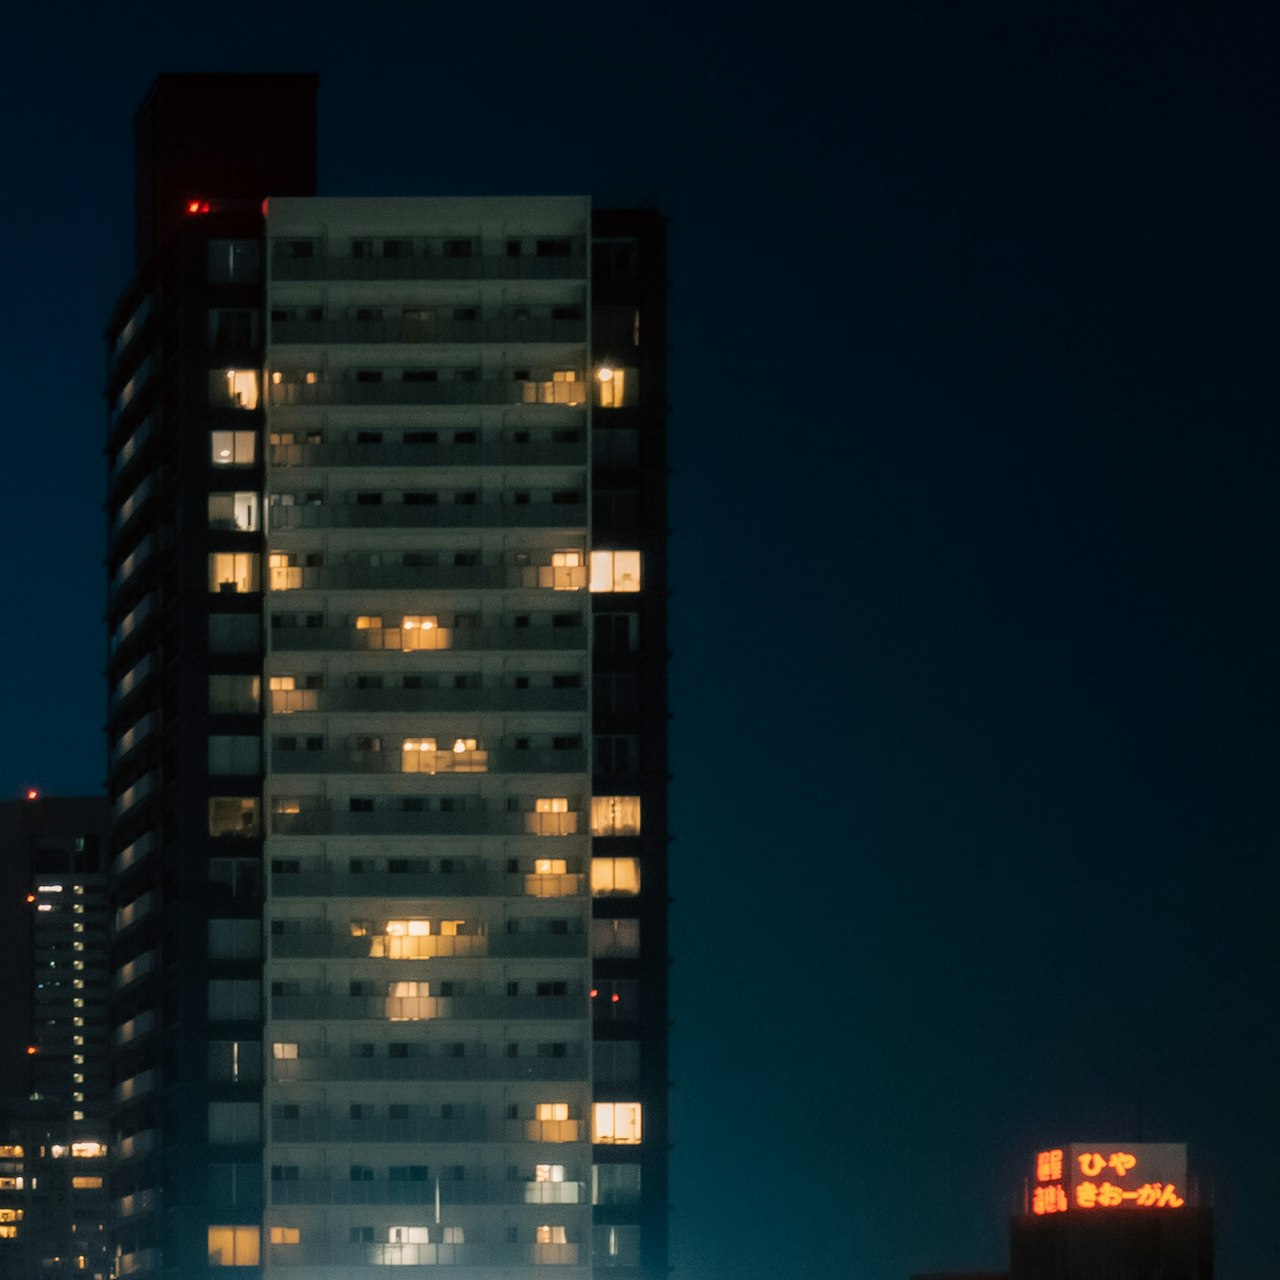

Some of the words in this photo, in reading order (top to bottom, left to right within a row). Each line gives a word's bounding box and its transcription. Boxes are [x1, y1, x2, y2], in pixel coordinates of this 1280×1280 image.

[1078, 1151, 1137, 1177] ひや
[1075, 1181, 1185, 1209] きおーがん
